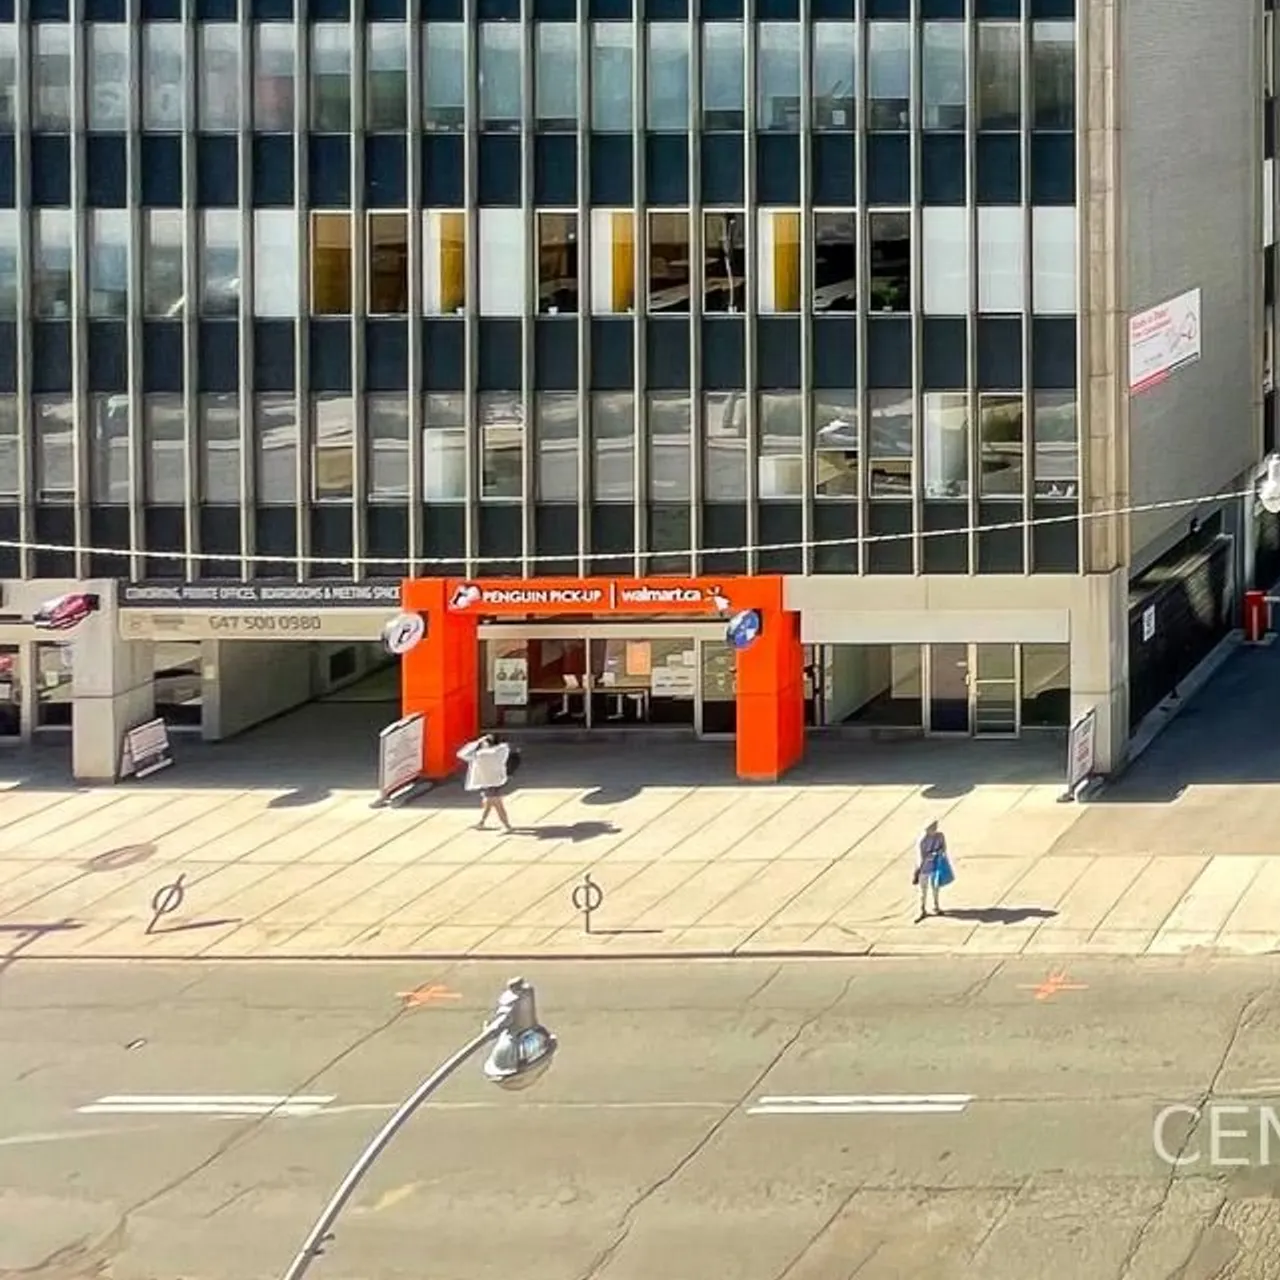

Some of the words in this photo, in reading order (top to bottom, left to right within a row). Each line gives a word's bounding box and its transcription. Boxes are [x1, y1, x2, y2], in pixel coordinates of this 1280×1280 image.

[482, 589, 548, 603] PENGUIN
[549, 589, 602, 603] PICK-UP
[621, 586, 702, 602] walmart.ca
